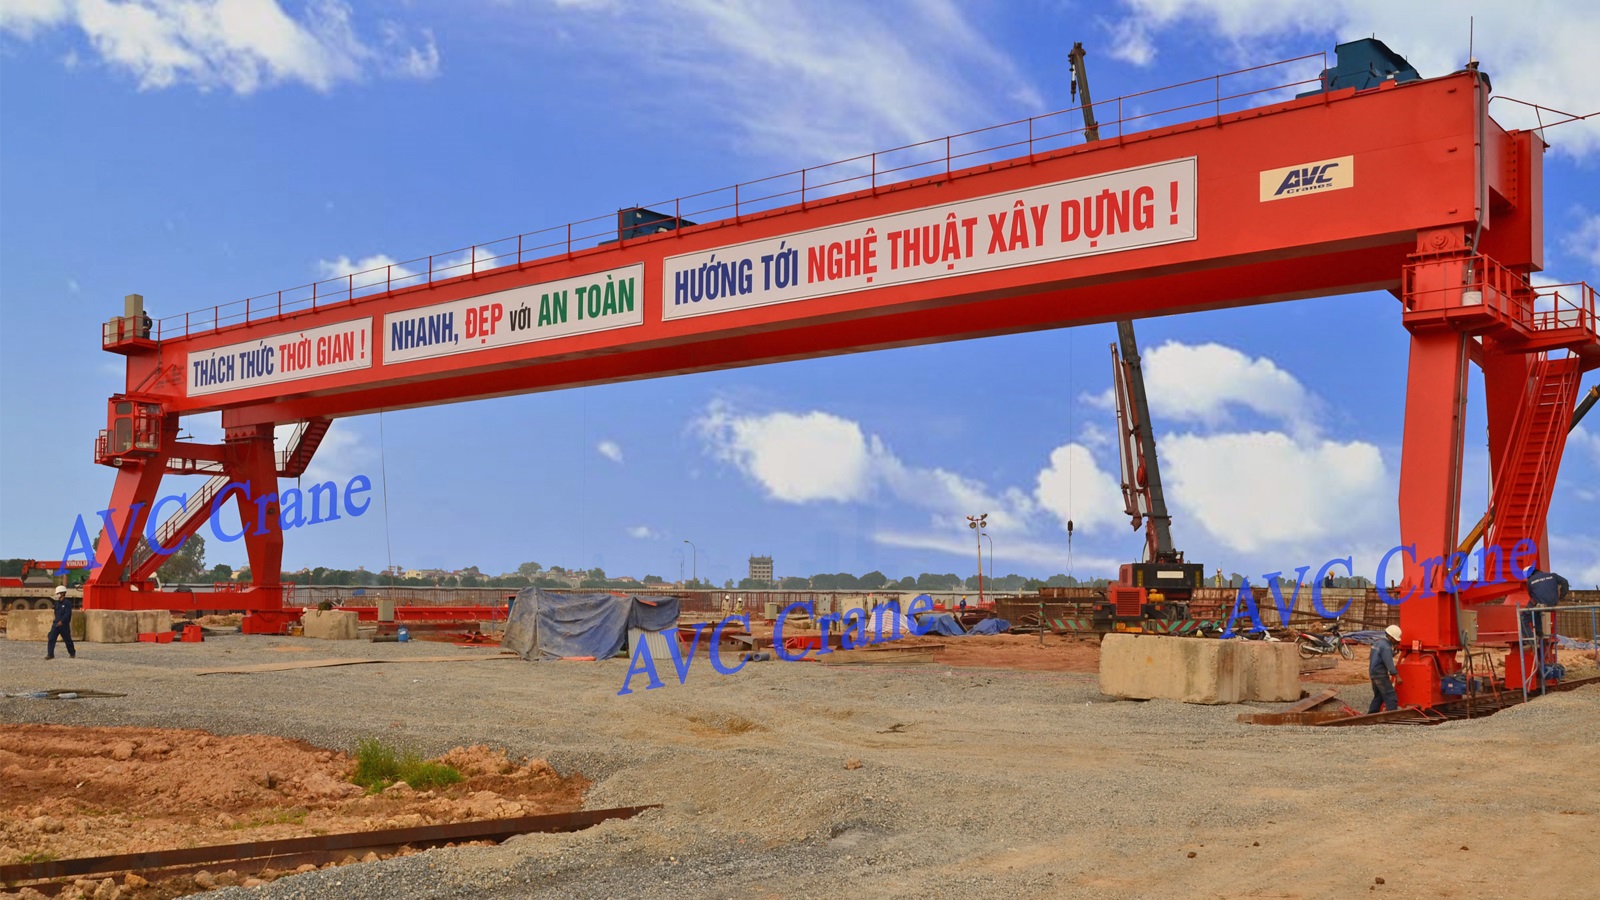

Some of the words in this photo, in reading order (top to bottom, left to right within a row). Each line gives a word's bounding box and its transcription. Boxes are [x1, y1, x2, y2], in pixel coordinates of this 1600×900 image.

[1274, 163, 1339, 196] AVC
[675, 254, 753, 305] HƯỚNG
[761, 241, 799, 291] TỚI
[807, 227, 878, 284] NGHỆ
[887, 212, 978, 270] THUẬT
[987, 200, 1049, 254] XÂY
[1060, 185, 1155, 248] DỰNG
[391, 311, 459, 352] NHANH,
[465, 303, 503, 344] ĐẸP
[537, 290, 568, 327] AN
[575, 274, 635, 321] TOÀN
[193, 352, 235, 387] THÁCH
[239, 340, 275, 380] THỨC
[279, 333, 312, 373] THỜI
[316, 331, 355, 367] GIAN
